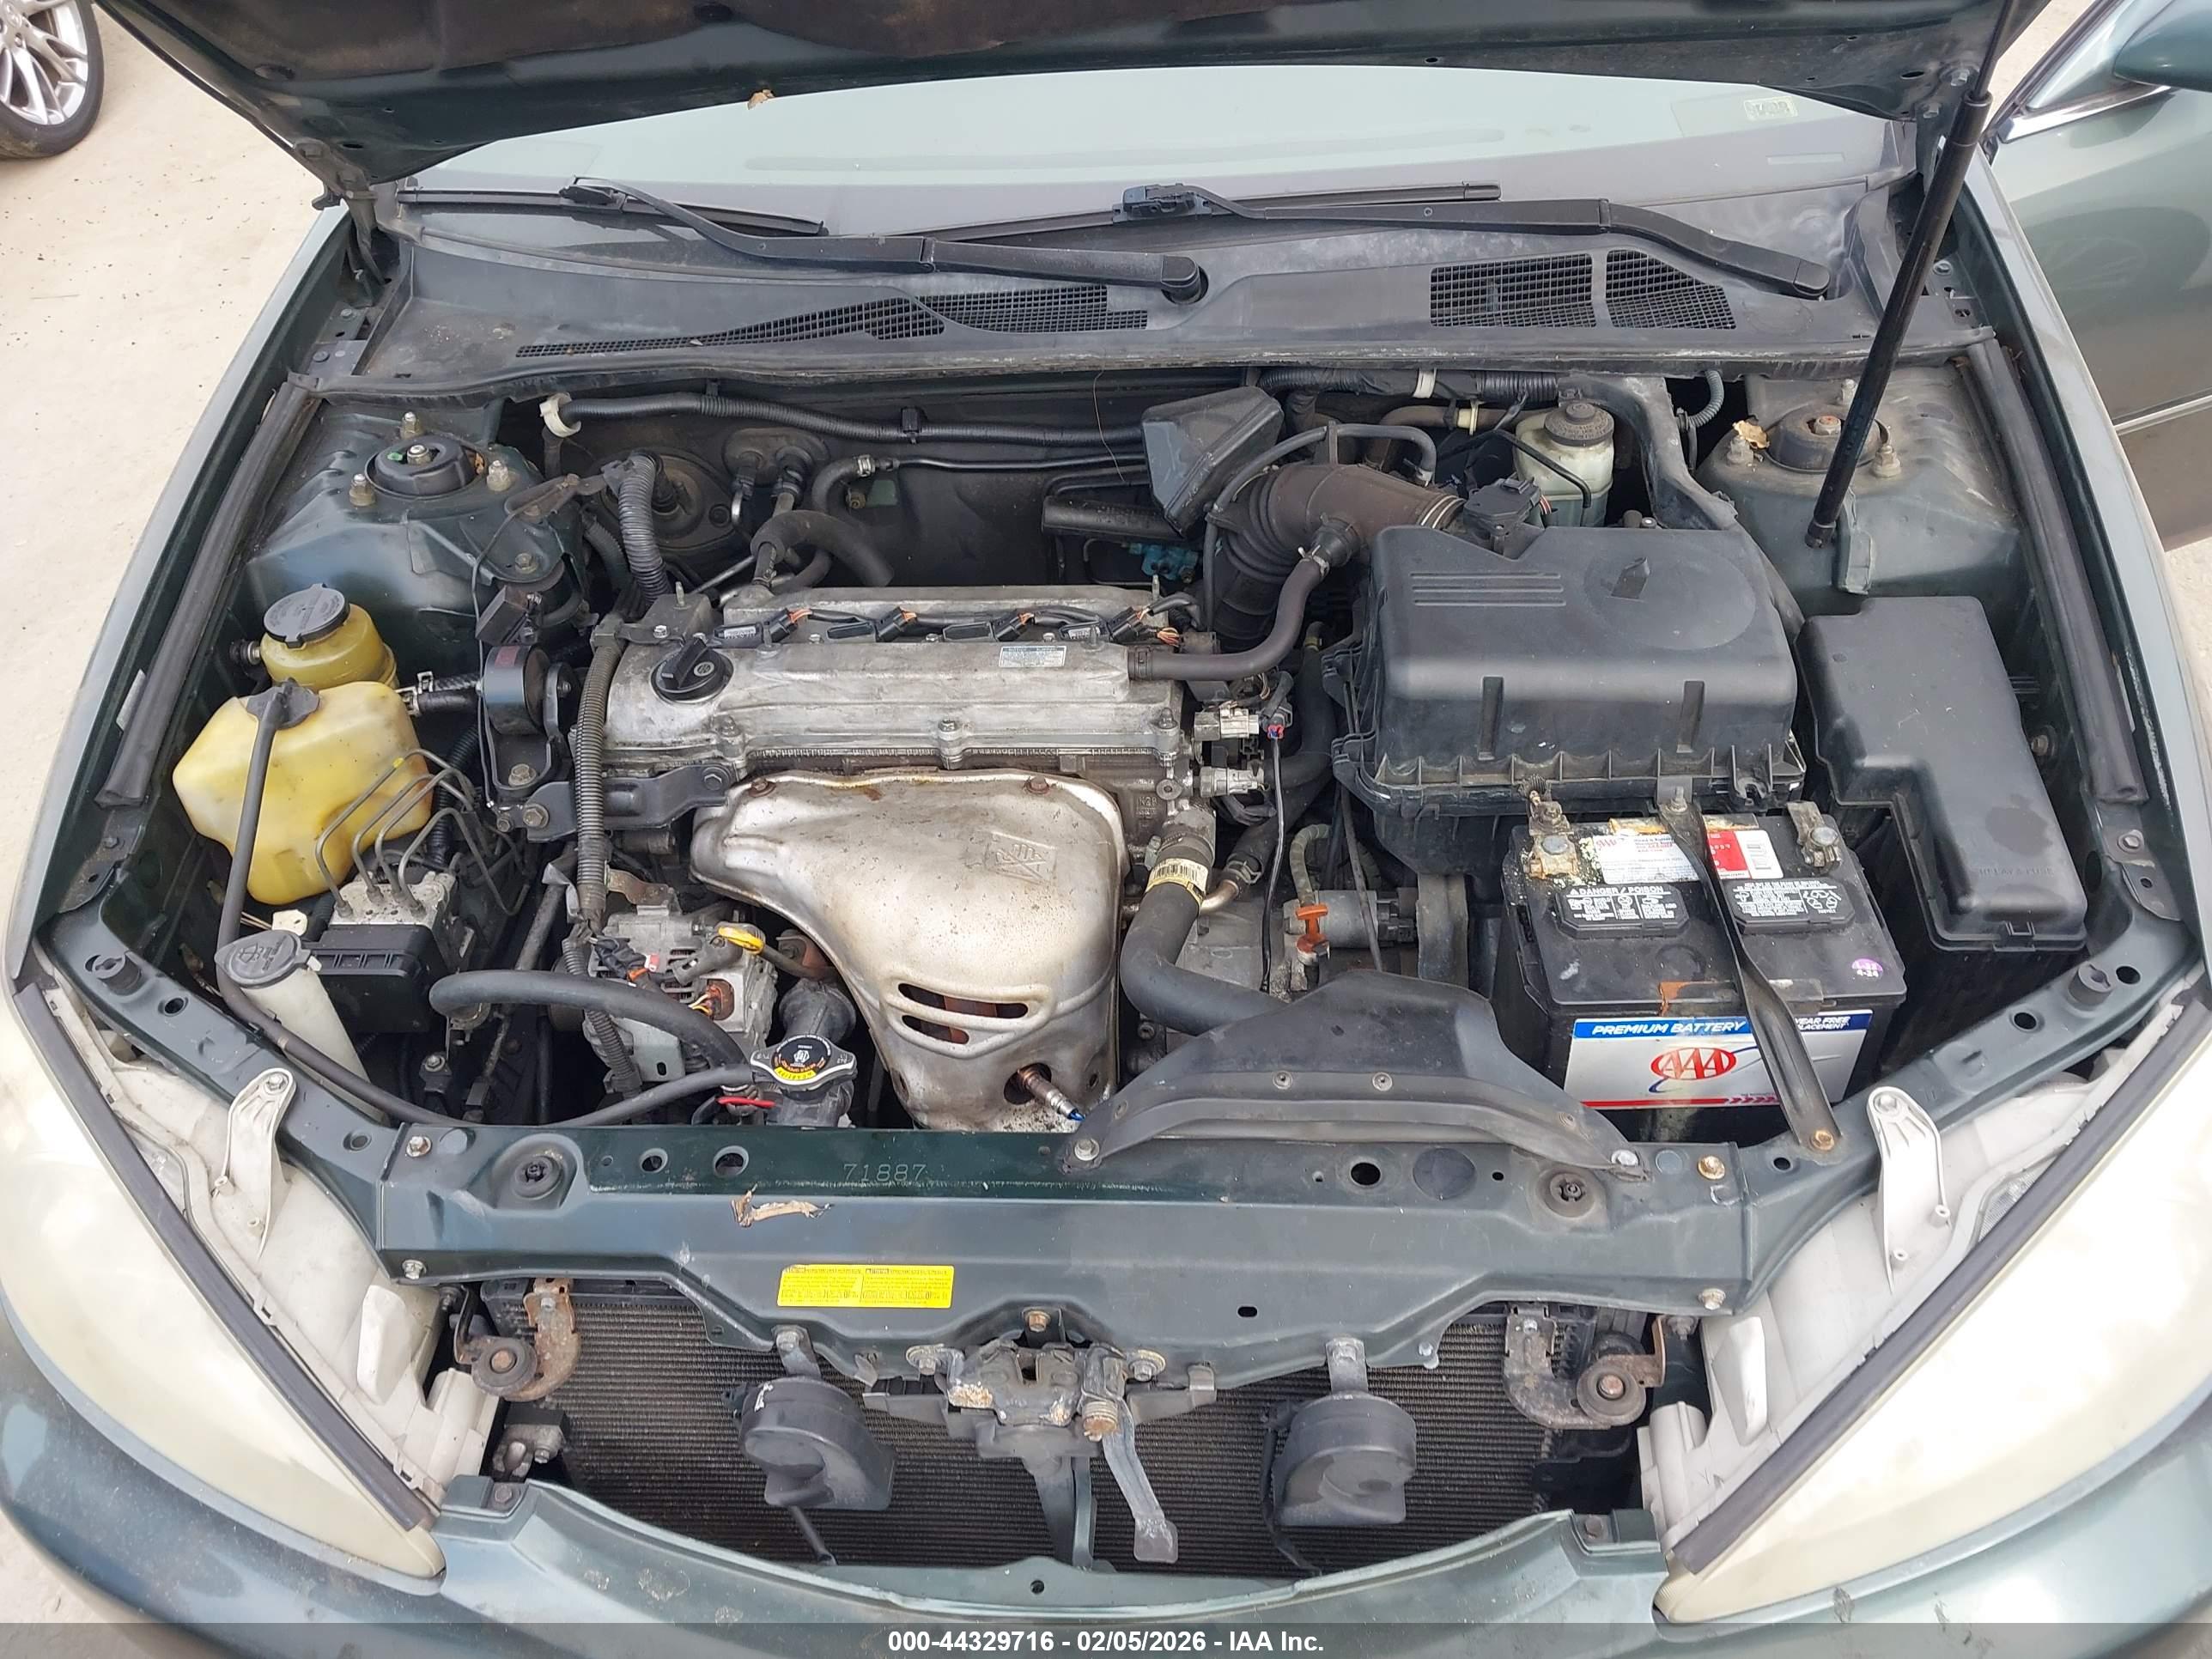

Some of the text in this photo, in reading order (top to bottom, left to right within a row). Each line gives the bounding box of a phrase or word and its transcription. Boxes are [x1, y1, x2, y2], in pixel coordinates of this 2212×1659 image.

[1627, 885, 1664, 894] POISON
[1822, 1016, 1851, 1025] FREE
[1591, 1021, 1747, 1036] PREMIUM BATTERY
[1658, 1047, 1729, 1079] AAA
[843, 1164, 927, 1182] 71887
